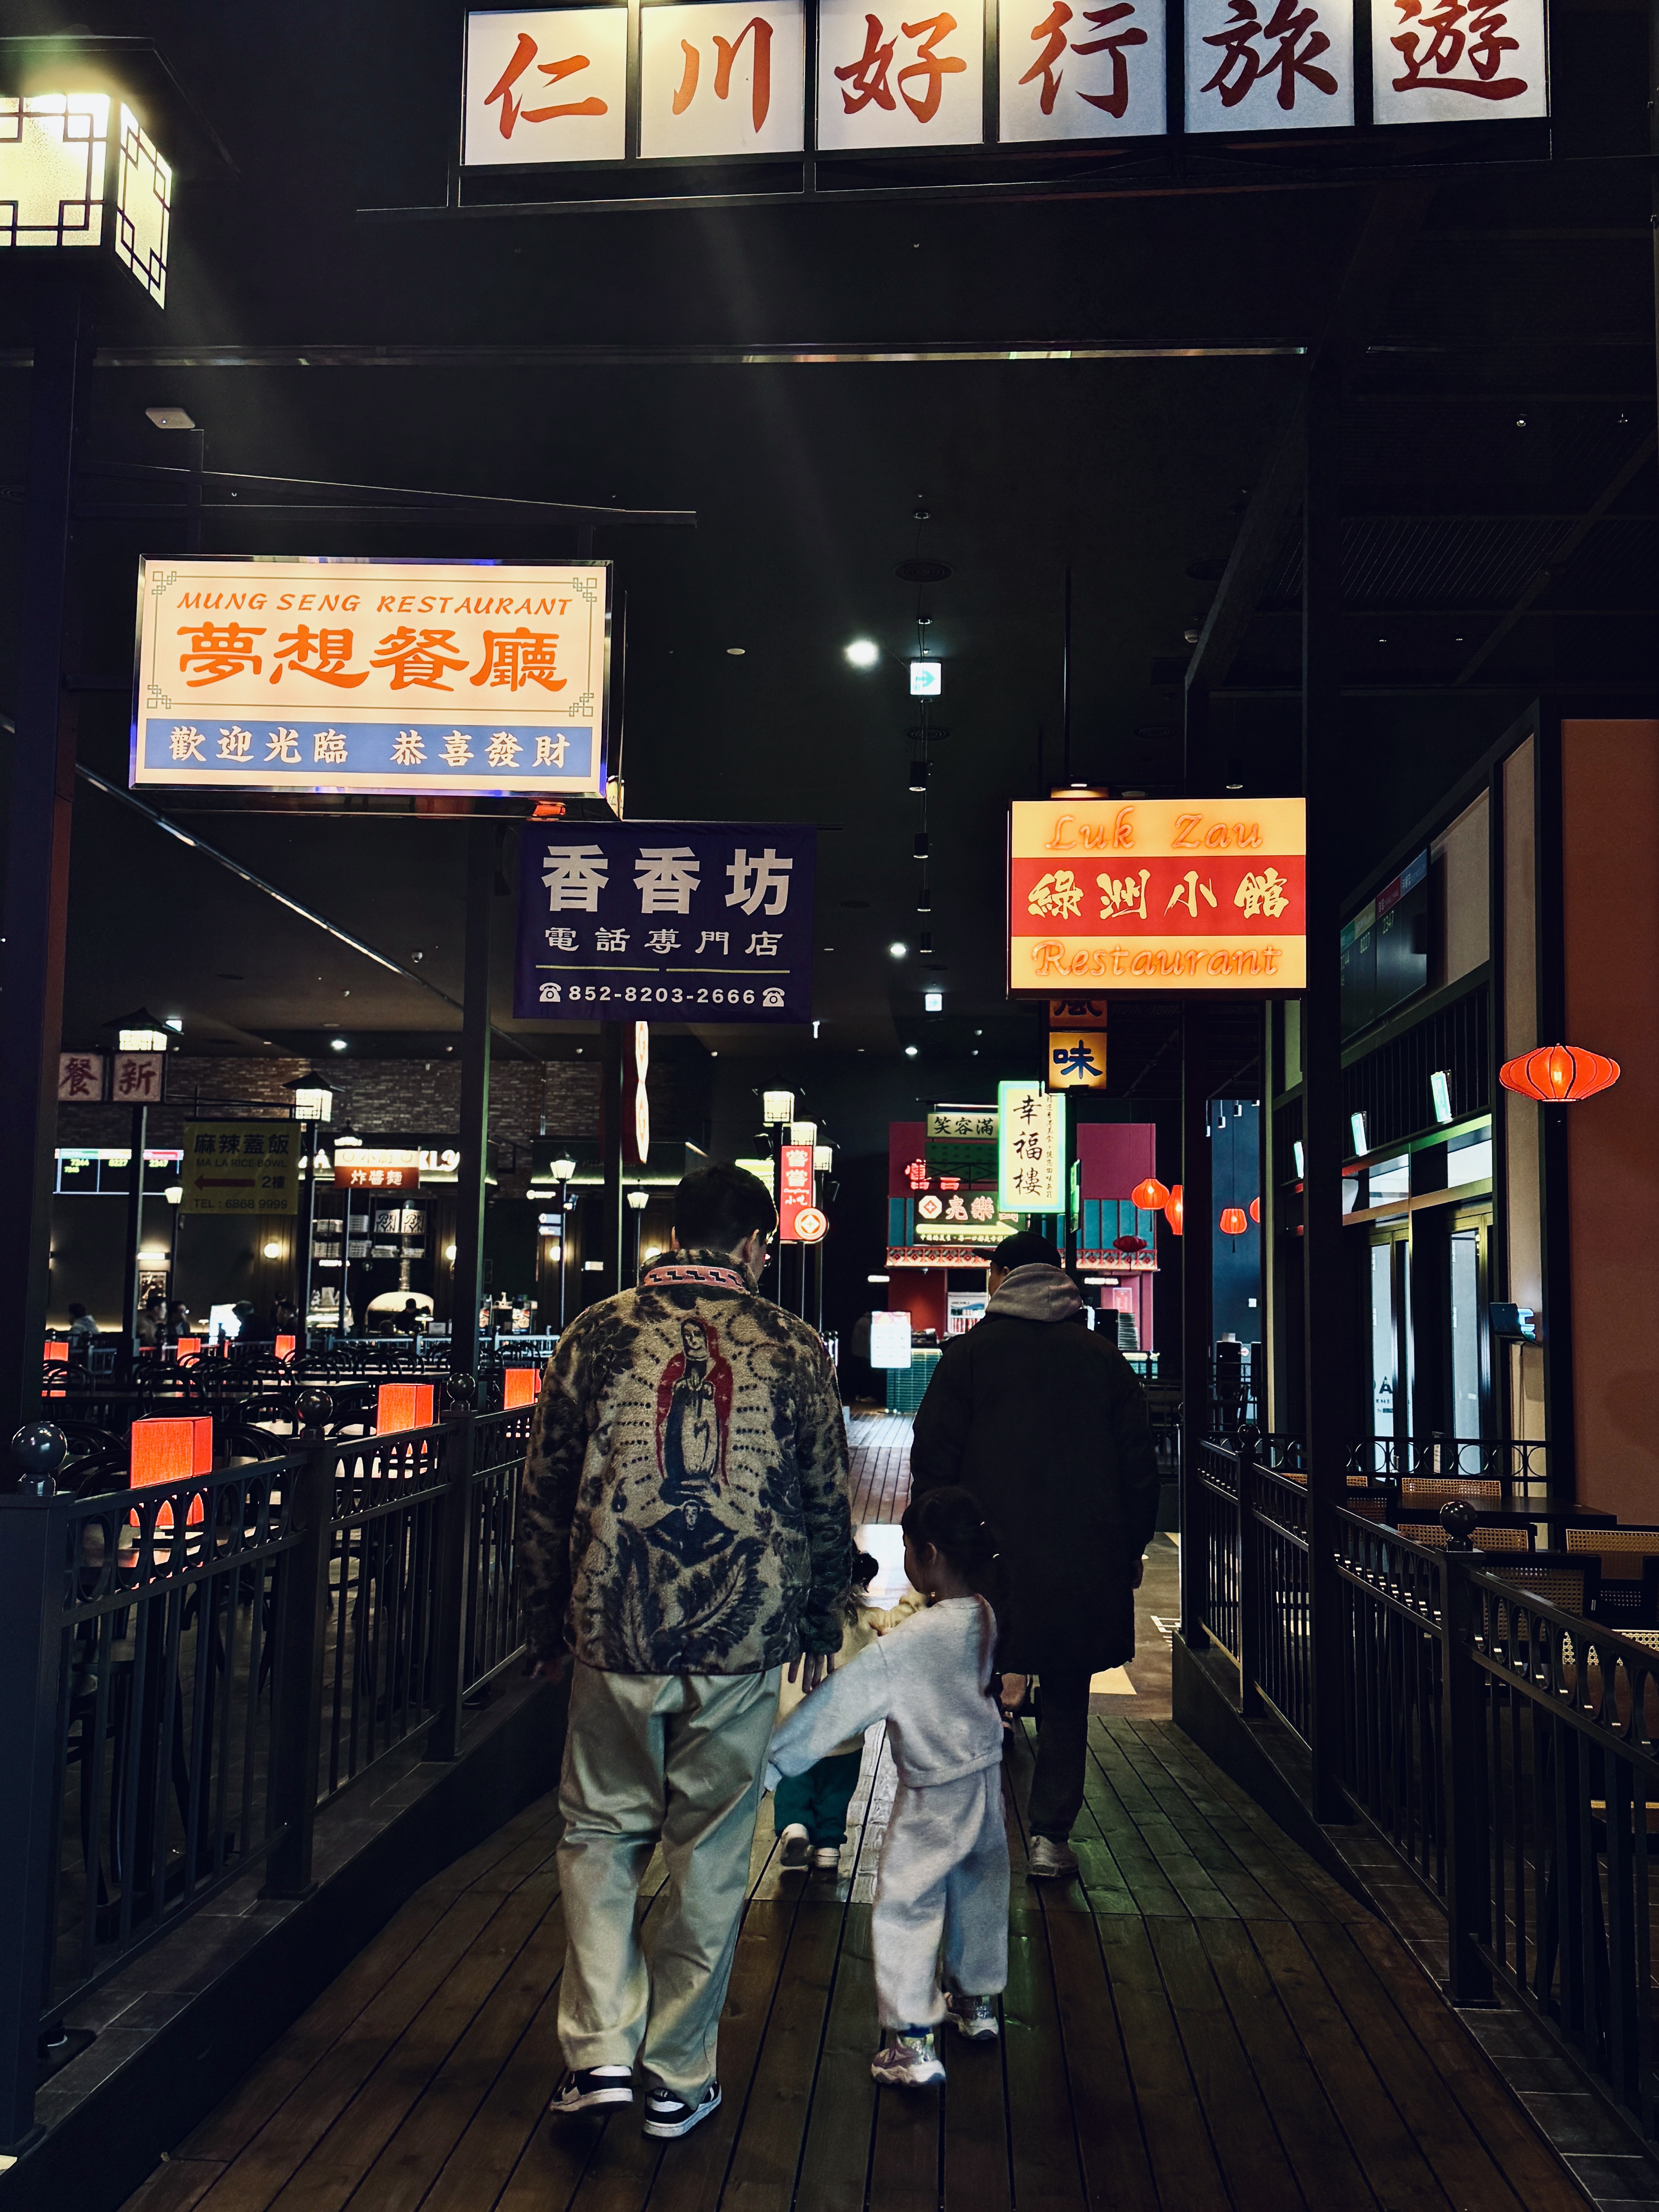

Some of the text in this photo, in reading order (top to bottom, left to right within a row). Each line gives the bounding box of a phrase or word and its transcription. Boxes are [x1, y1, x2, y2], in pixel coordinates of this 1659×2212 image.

[484, 0, 1528, 140] 仁川好行旅遊
[177, 592, 573, 616] MUNG SENG RESTAURANT
[177, 621, 567, 692] 夢想餐廳
[169, 726, 570, 769] 歡迎光臨 恭喜發財
[1045, 806, 1263, 850] Luk Zau
[541, 845, 793, 916] 香香坊
[1031, 940, 1282, 977] Restaurant
[568, 986, 755, 1004] 852-8203-2666
[194, 1133, 290, 1154] 麻辣蓋飯
[934, 1116, 994, 1135] 笑容滿
[1013, 1095, 1042, 1196] 幸福樓
[231, 1159, 254, 1167] RICE
[258, 1159, 287, 1167] BOWL
